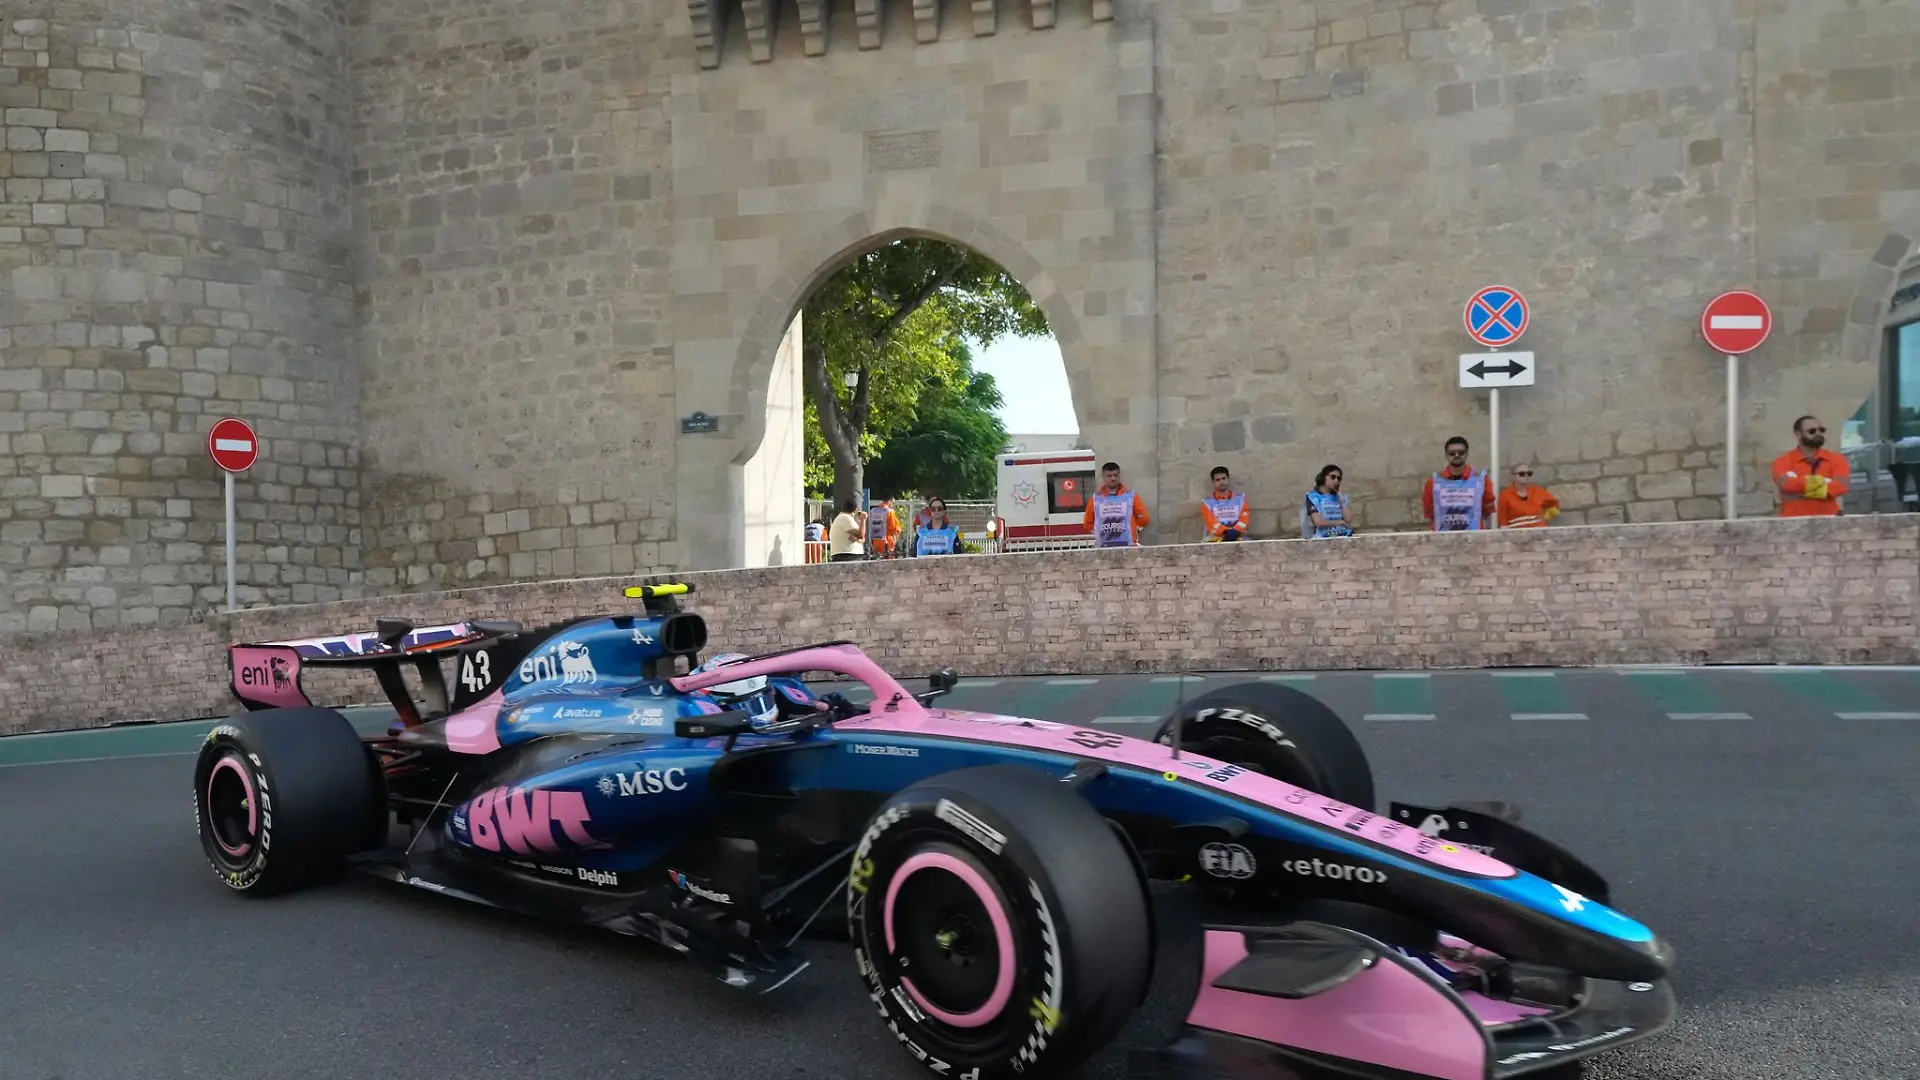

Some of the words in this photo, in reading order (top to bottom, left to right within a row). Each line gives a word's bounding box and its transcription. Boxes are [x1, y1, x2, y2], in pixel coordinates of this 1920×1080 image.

[241, 660, 269, 686] eni
[461, 650, 492, 693] 43
[519, 646, 557, 683] eni
[563, 707, 602, 719] avature
[1065, 731, 1124, 749] 43
[616, 767, 688, 798] MSC
[1206, 764, 1248, 783] BWT
[256, 772, 273, 851] ZERO
[469, 785, 606, 855] BWT
[576, 867, 618, 887] Delphi
